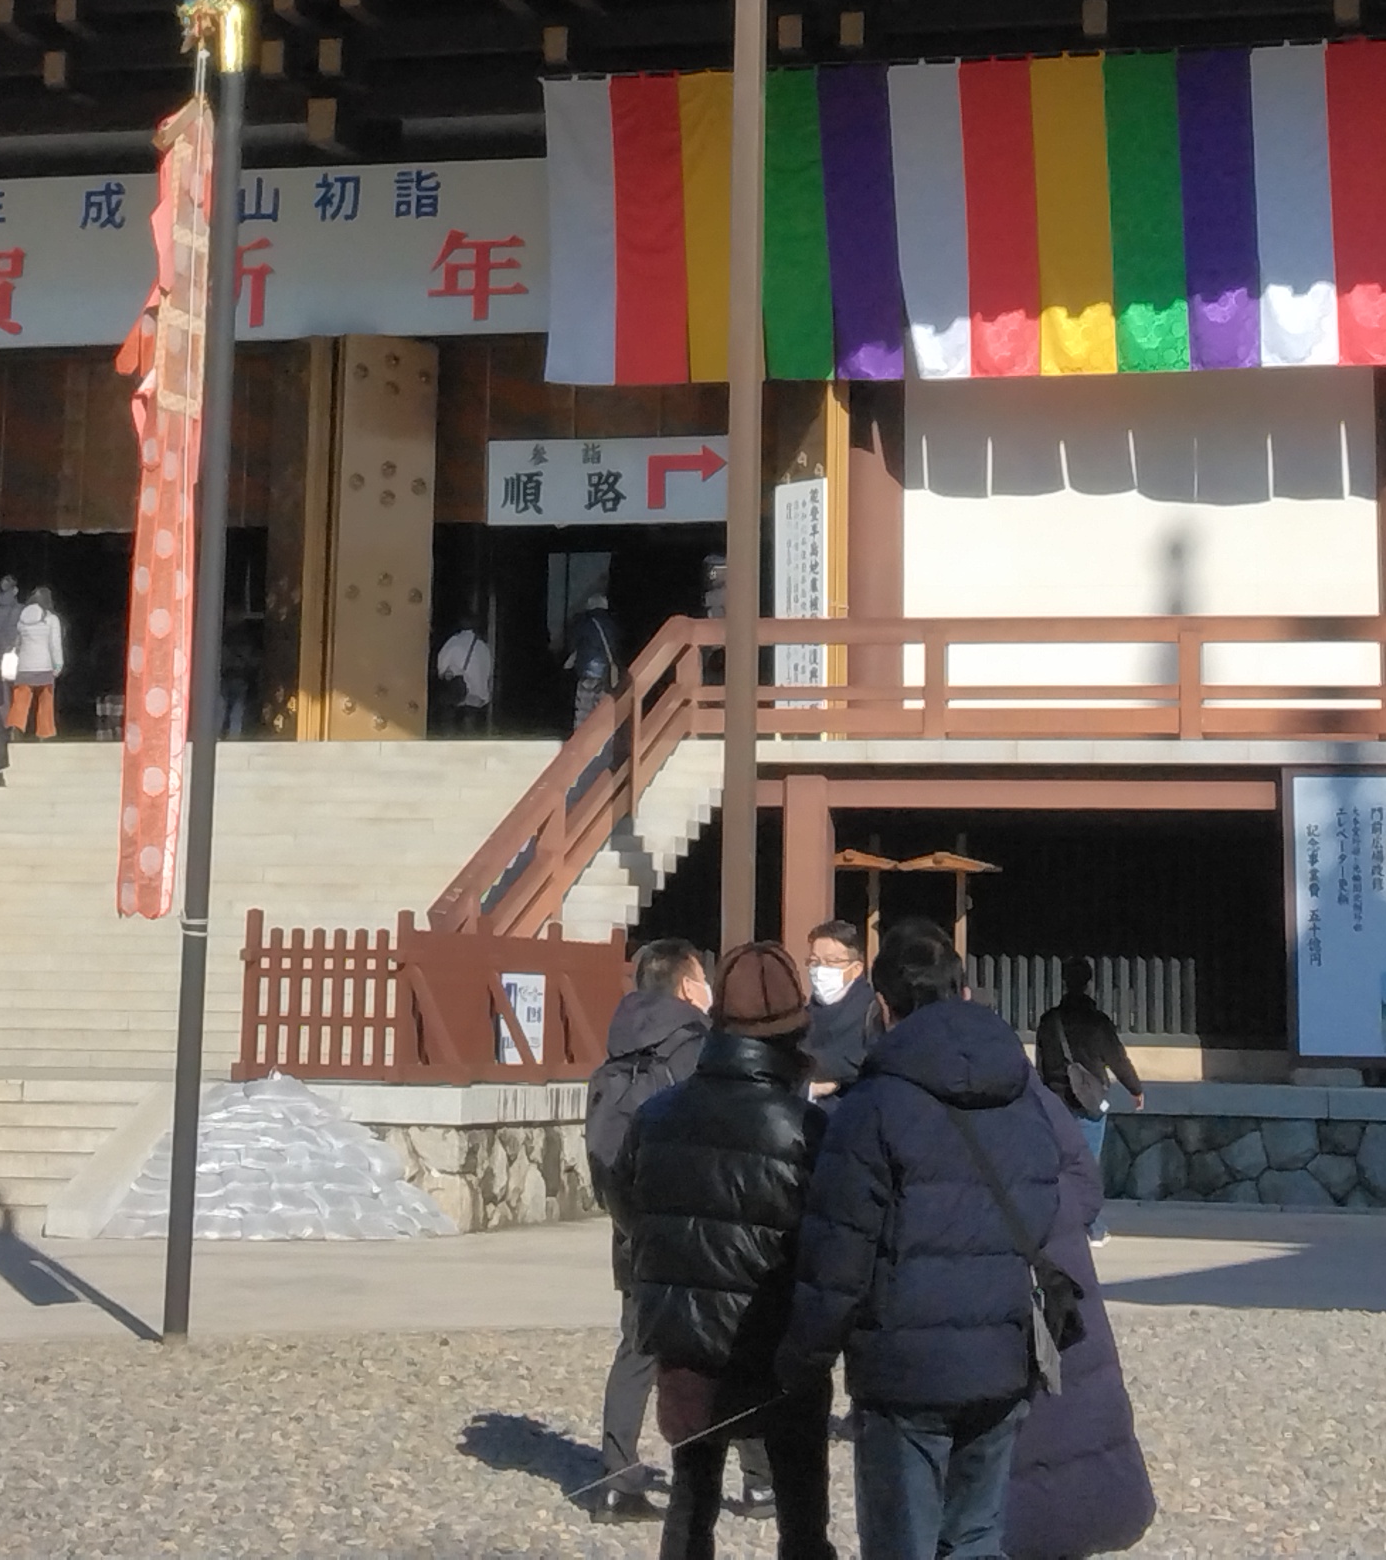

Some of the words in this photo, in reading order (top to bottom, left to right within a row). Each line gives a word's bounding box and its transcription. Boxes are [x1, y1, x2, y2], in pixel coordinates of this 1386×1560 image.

[79, 169, 441, 230] 成山初詣
[528, 442, 602, 466] 参詣
[500, 469, 628, 515] 順路
